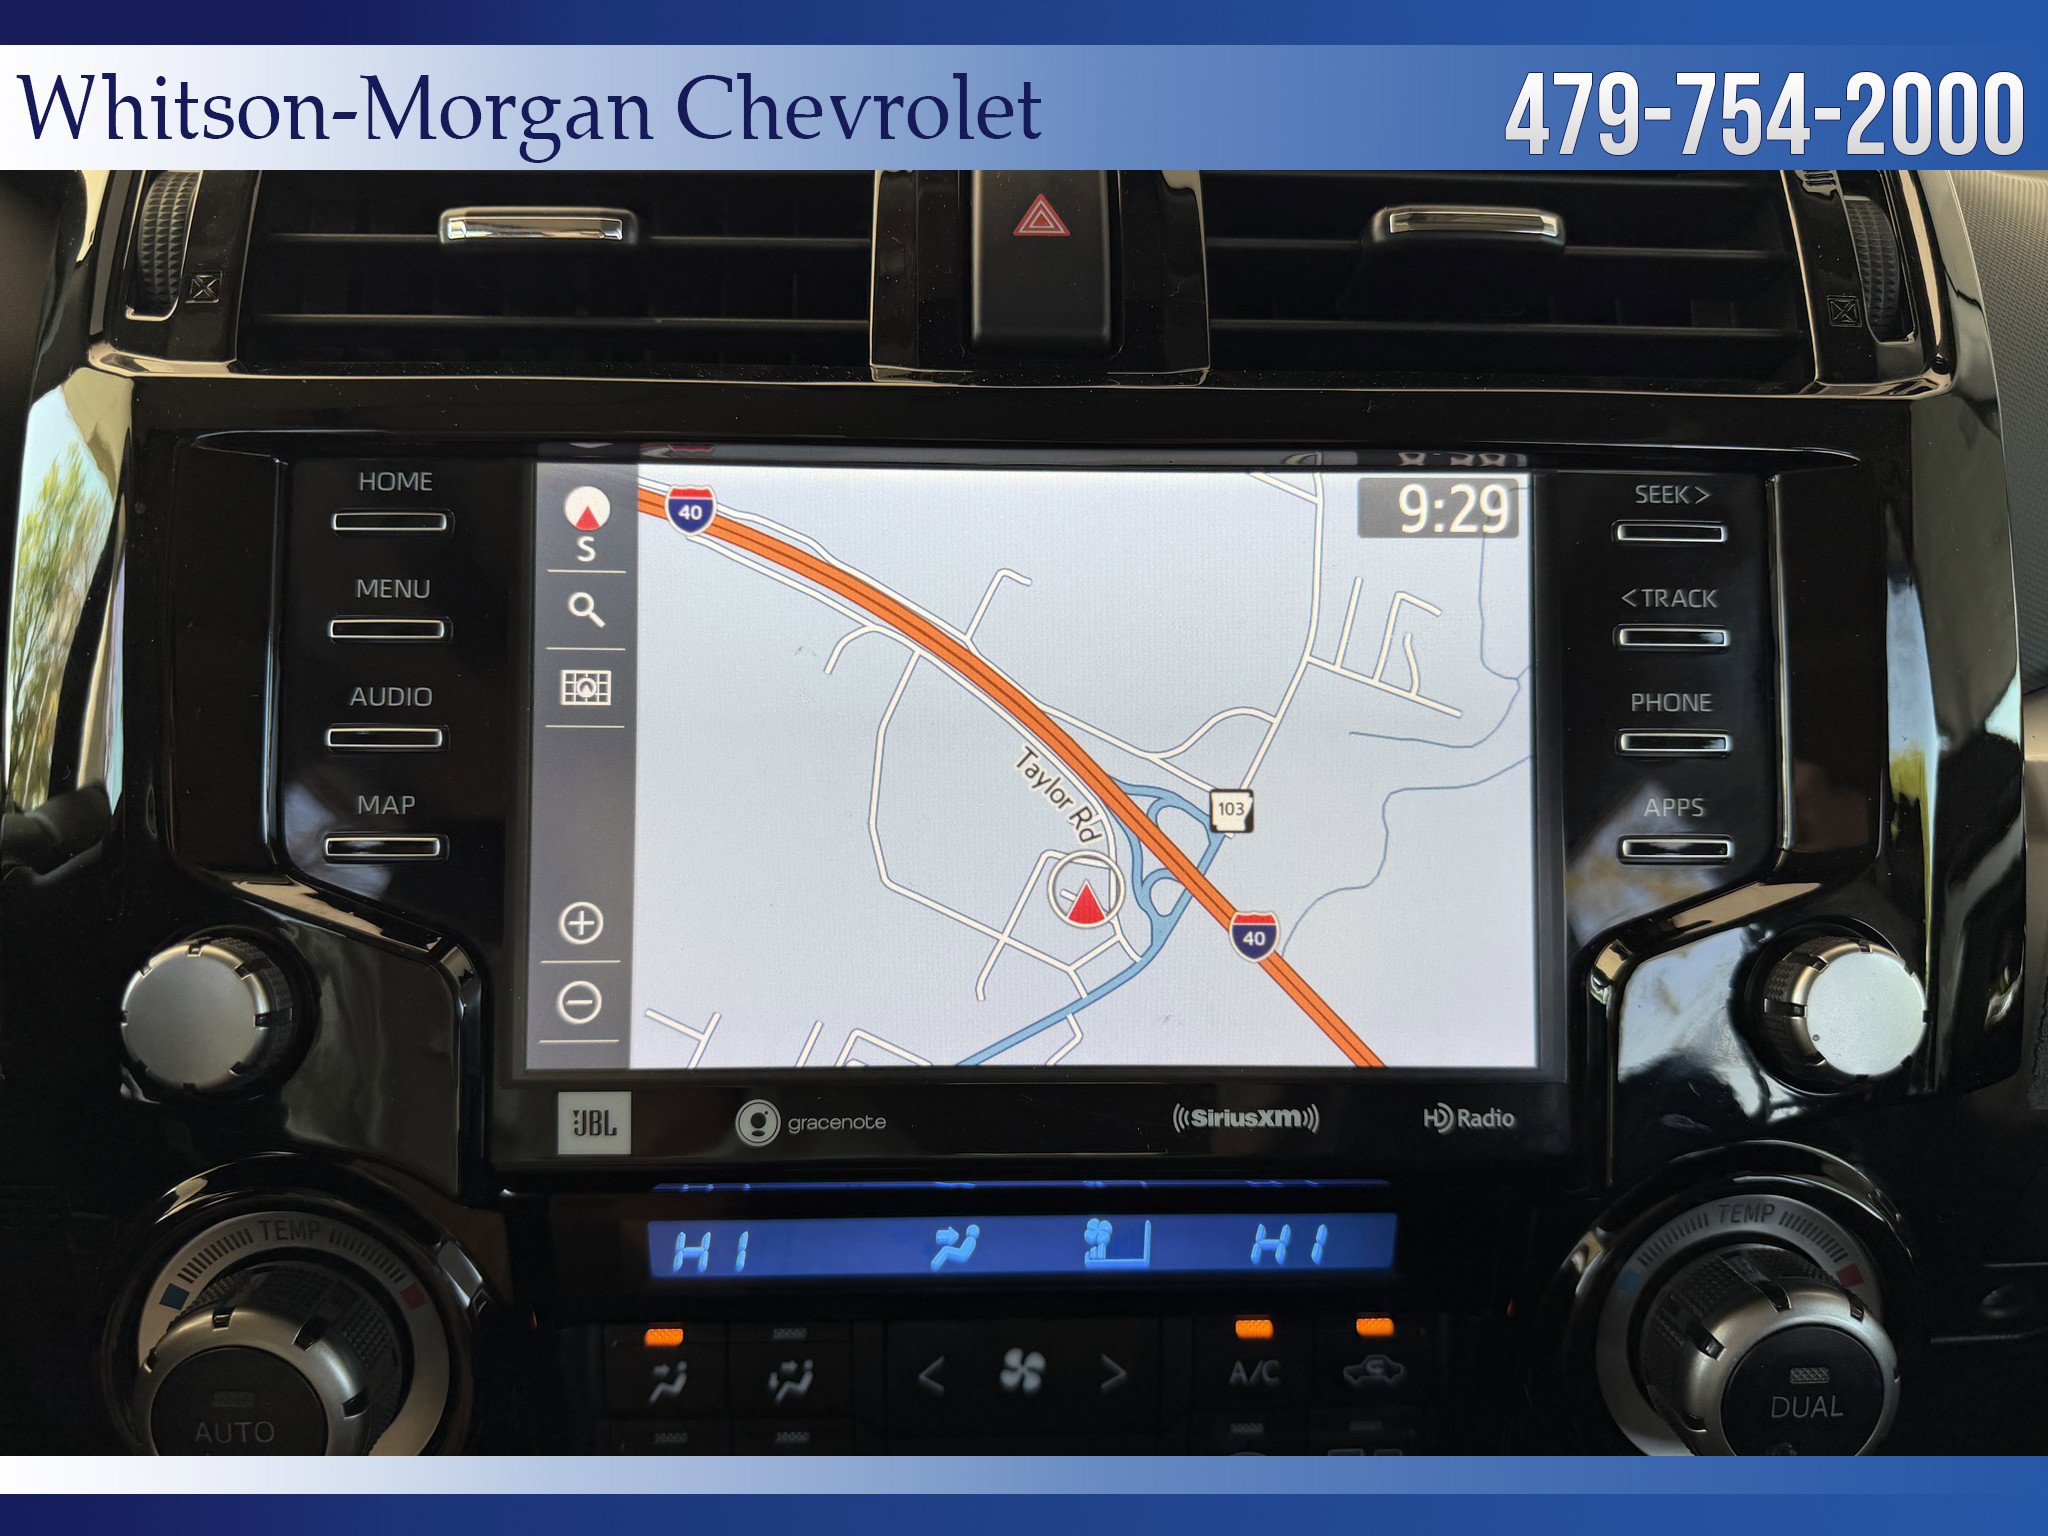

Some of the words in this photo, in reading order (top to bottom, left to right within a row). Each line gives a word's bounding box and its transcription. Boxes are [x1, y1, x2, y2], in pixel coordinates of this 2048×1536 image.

[359, 471, 433, 492] HOME
[678, 504, 704, 521] 40
[1398, 483, 1510, 534] 9:29
[576, 536, 597, 563] S
[356, 579, 431, 599] MENU
[350, 686, 433, 707] AUDIO
[1631, 693, 1712, 713] PHONE
[1015, 746, 1073, 808] Taylor
[1069, 806, 1102, 843] Rd
[357, 795, 416, 816] MAP
[1218, 801, 1245, 817] 103
[1644, 798, 1705, 818] APPS
[1242, 931, 1266, 946] 40
[573, 1109, 618, 1137] JBL
[787, 1112, 887, 1134] gracenote
[1457, 1106, 1515, 1129] Radio
[1717, 1203, 1776, 1224] TEMP
[258, 1219, 323, 1241] TEMP
[1229, 1360, 1280, 1387] A/C
[1770, 1395, 1844, 1419] DUAL
[195, 1421, 275, 1443] AUTO
